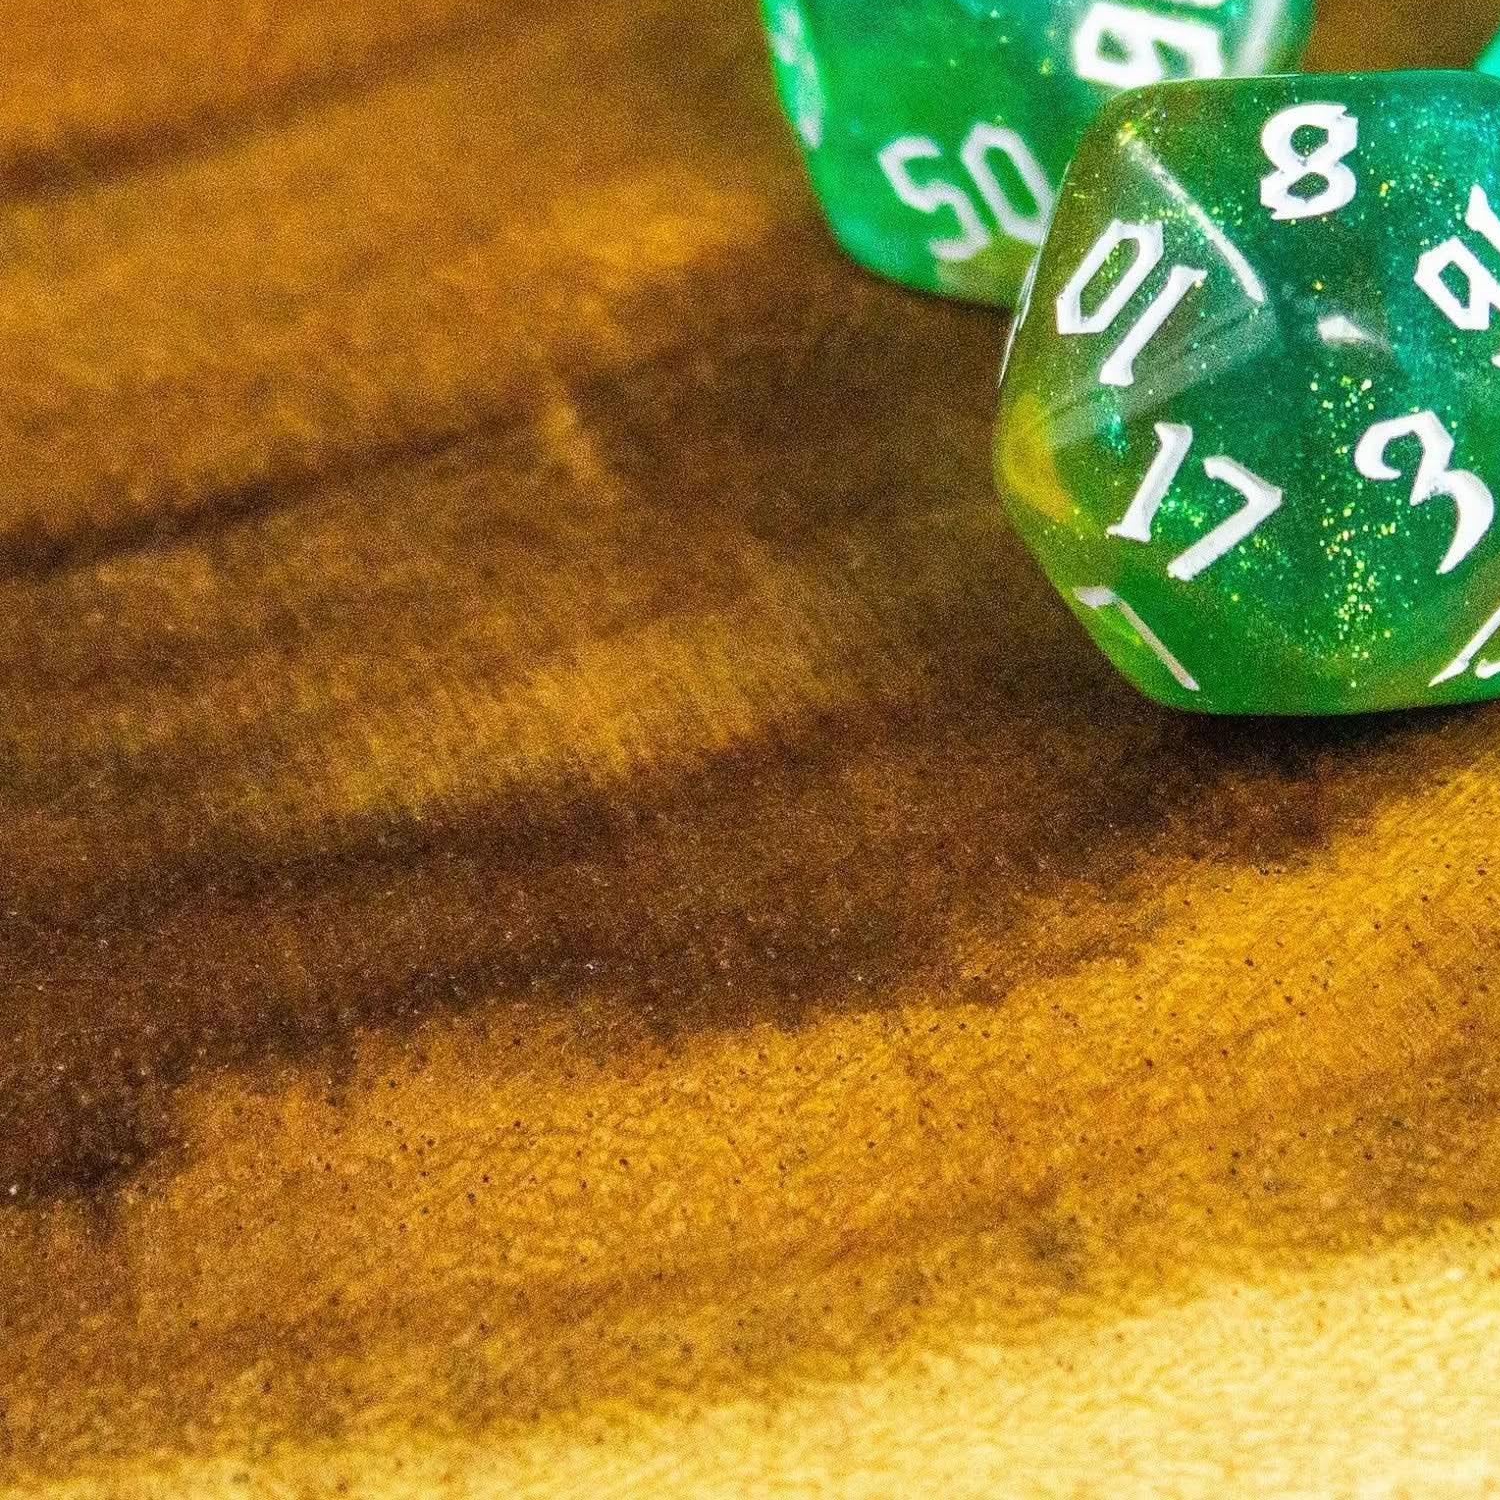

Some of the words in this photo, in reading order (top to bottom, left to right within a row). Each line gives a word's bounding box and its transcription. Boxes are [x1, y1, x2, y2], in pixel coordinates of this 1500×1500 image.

[878, 120, 1050, 262] 50
[1258, 102, 1360, 220] 8
[1054, 218, 1208, 388] 10
[1106, 422, 1284, 582] 17
[1354, 410, 1496, 574] 3
